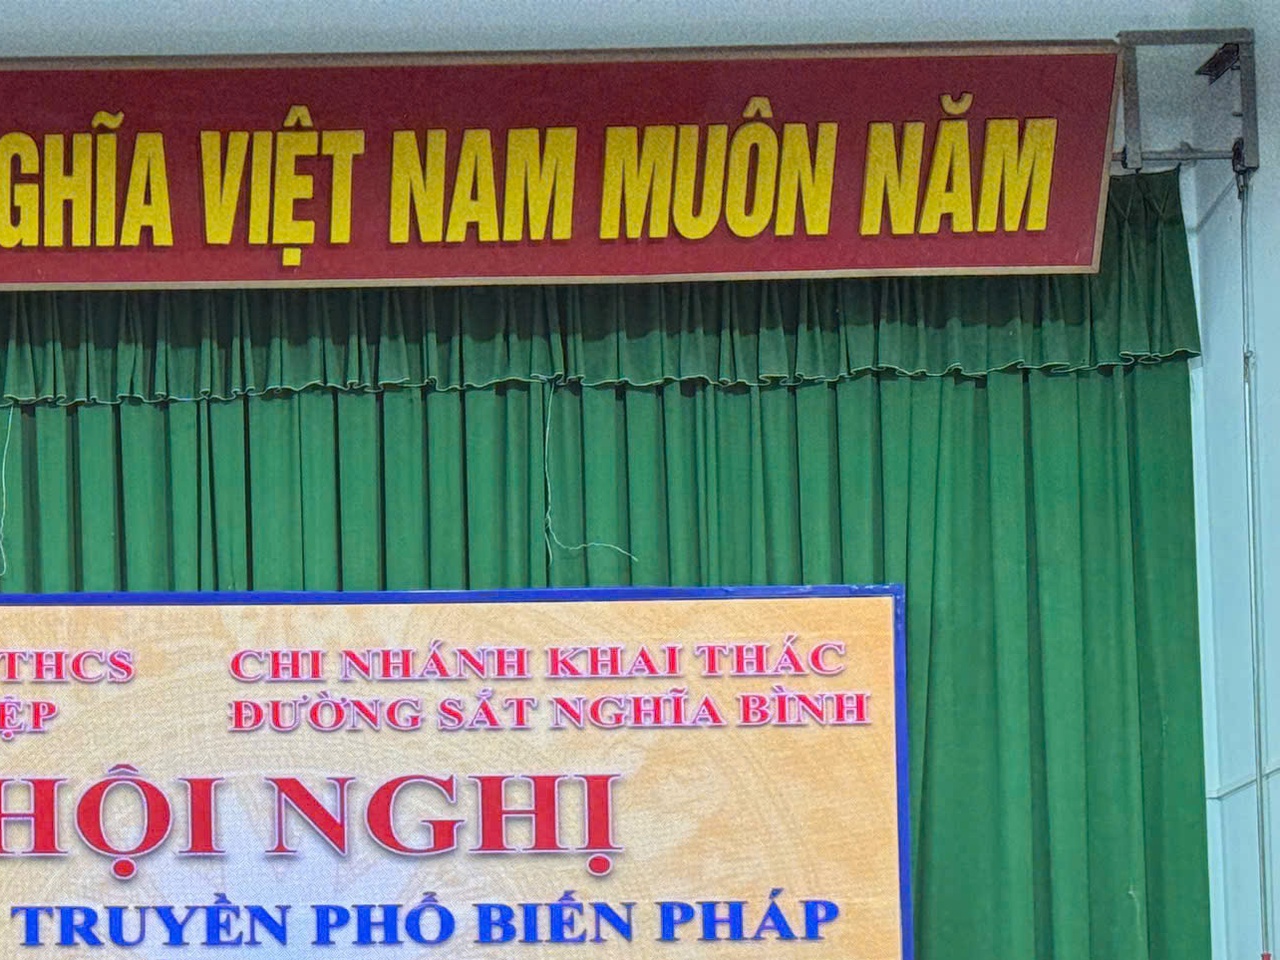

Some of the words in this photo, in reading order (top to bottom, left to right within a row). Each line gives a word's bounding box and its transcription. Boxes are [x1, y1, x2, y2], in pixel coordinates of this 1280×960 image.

[200, 106, 365, 266] VIỆT
[389, 127, 578, 244] NAM
[599, 97, 838, 240] MUÔN
[860, 92, 1058, 236] NĂM
[228, 649, 325, 681] CHI
[341, 640, 532, 680] NHÁNH
[546, 645, 683, 678] KHAI
[694, 634, 846, 676] THÁC
[227, 690, 423, 732] ĐƯỜNG
[437, 687, 538, 731] SẮT
[550, 686, 727, 728] NGHĨA
[736, 685, 872, 725] BÌNH
[265, 774, 622, 877] NGHỊ
[10, 893, 293, 948] TRUYỀN
[310, 891, 457, 947] PHỔ
[472, 889, 634, 944] BIẾN
[659, 887, 840, 942] PHÁP
